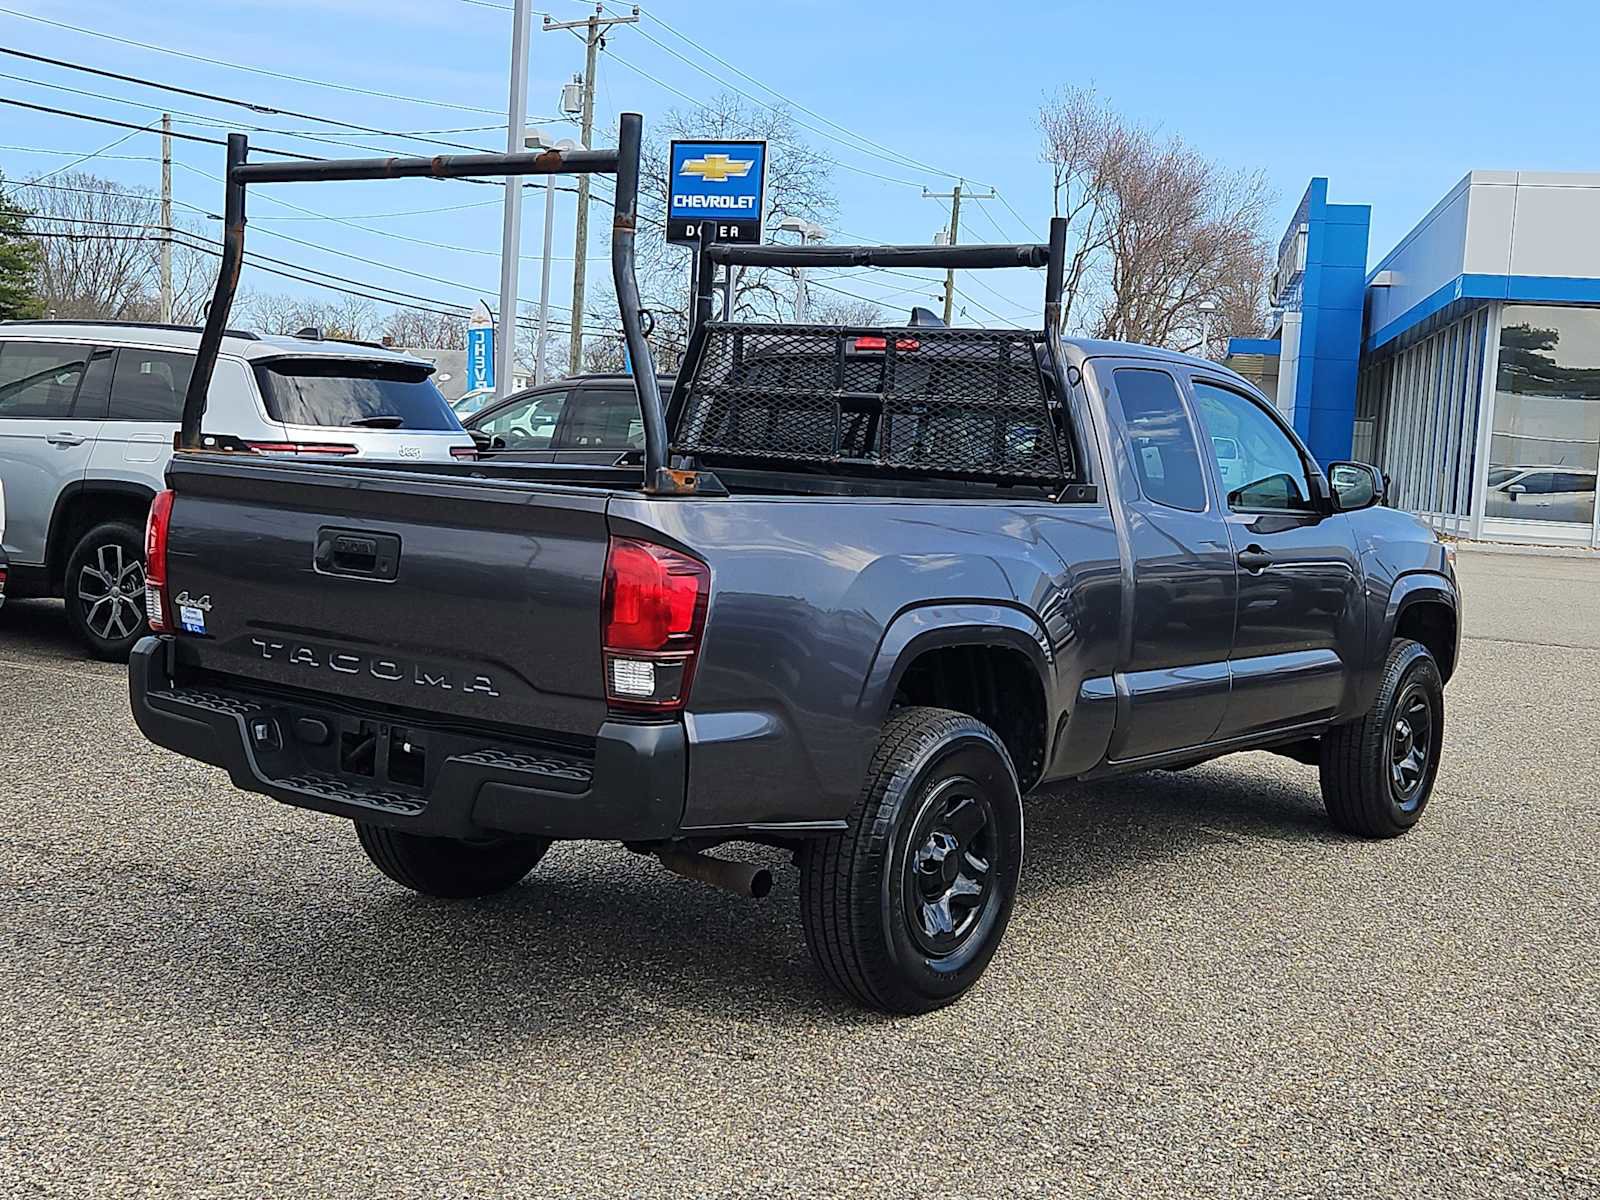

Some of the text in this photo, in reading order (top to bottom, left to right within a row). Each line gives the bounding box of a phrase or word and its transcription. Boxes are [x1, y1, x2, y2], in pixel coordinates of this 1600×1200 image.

[674, 195, 755, 208] CHEVROLET
[686, 225, 739, 237] DER
[175, 591, 213, 612] 4x4
[252, 638, 500, 697] TACOMA
